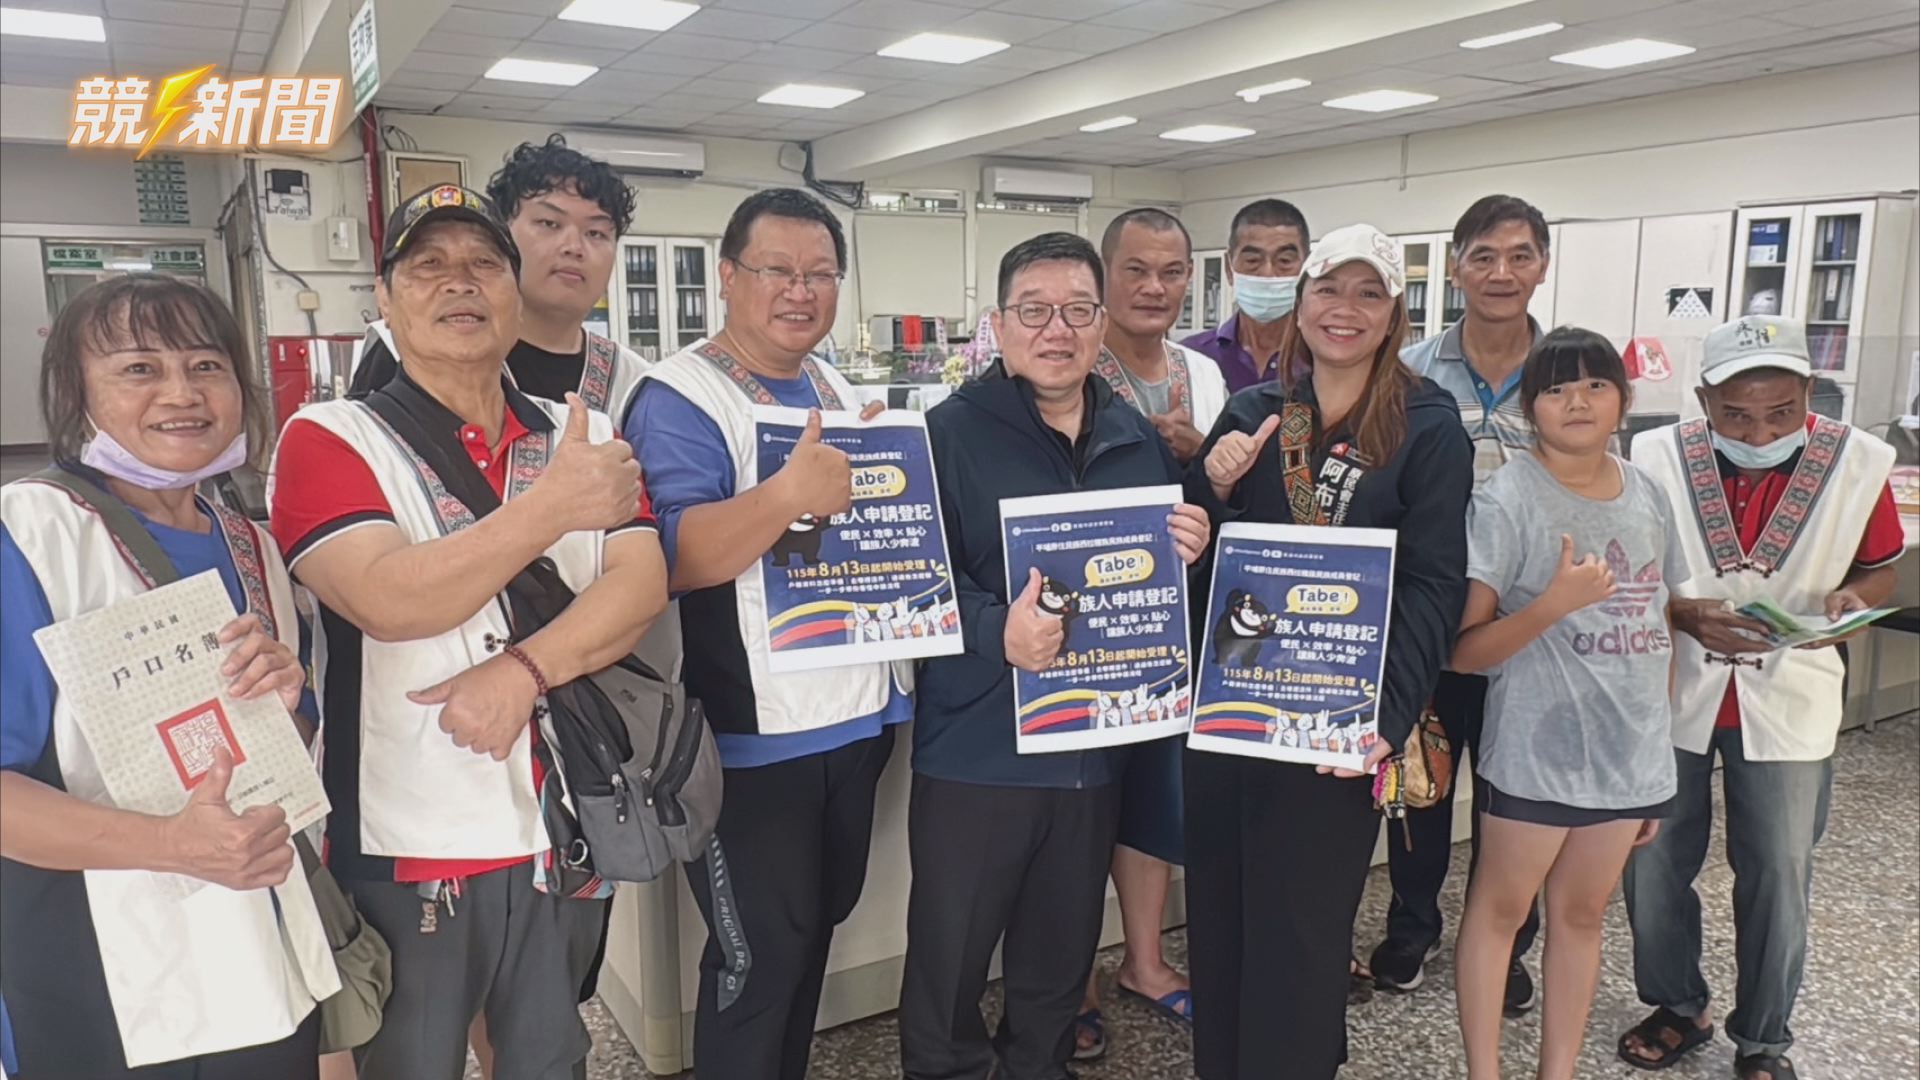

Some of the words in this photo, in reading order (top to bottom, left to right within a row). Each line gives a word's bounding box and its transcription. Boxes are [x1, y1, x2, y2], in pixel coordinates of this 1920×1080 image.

[1079, 586, 1178, 613] 族人申請登記
[123, 613, 180, 642] 中華民國
[1274, 618, 1378, 642] 族人申請登記
[1572, 624, 1670, 656] adidas
[112, 631, 221, 690] 戶口名簿
